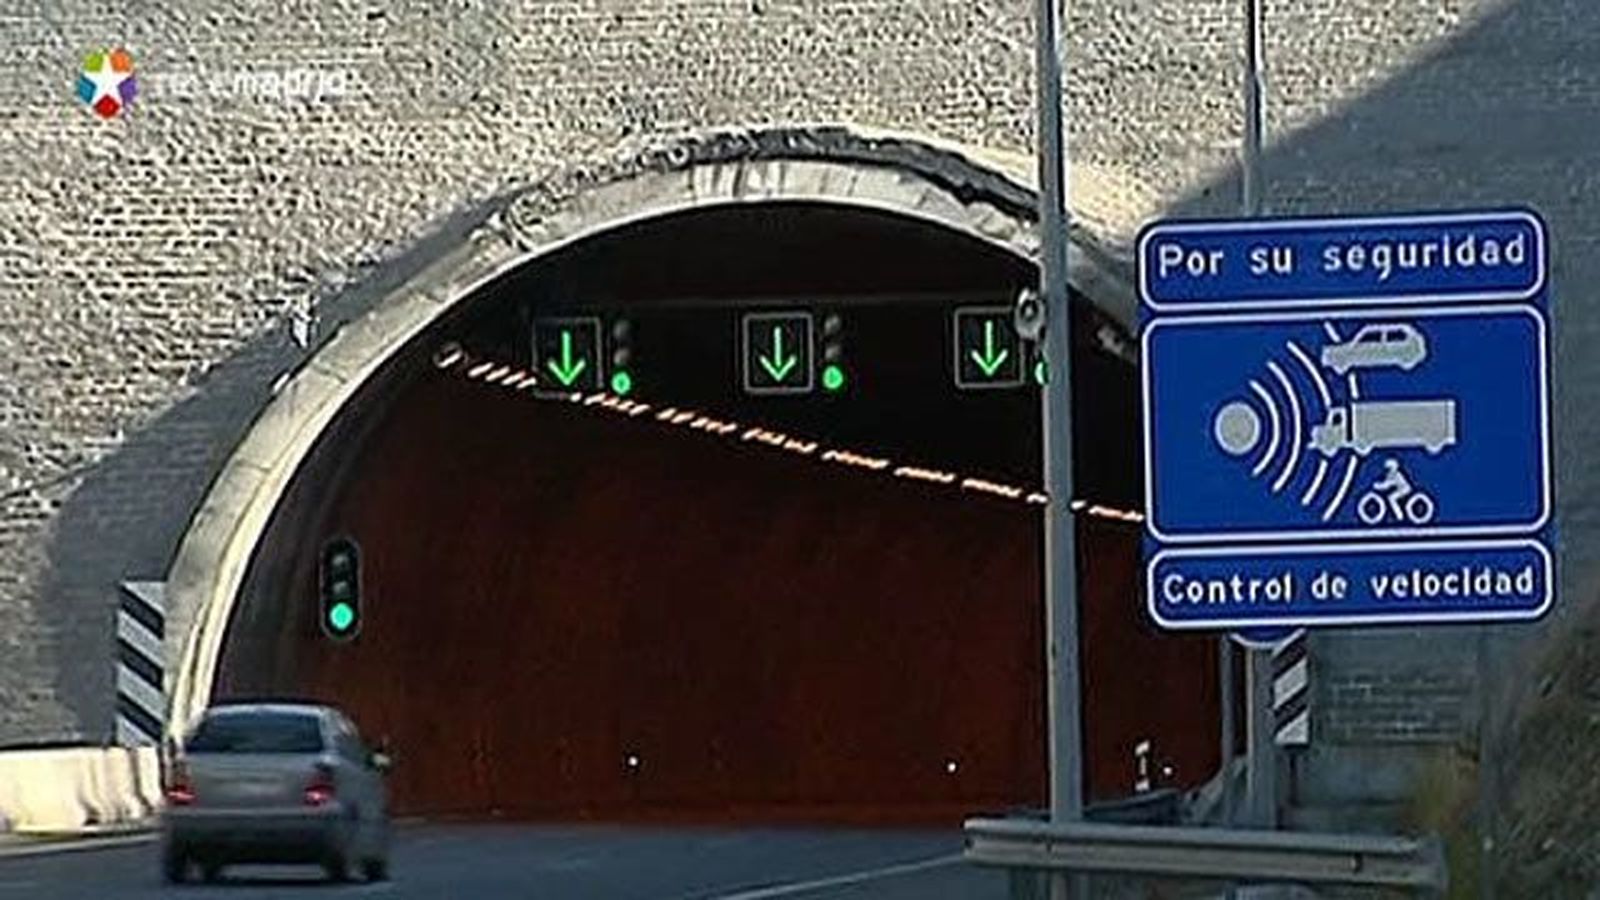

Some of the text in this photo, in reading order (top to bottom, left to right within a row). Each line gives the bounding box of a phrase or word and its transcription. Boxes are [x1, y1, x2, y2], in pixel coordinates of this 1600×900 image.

[1158, 233, 1525, 280] Por su seguridad
[1163, 566, 1534, 602] Control de velocidad
